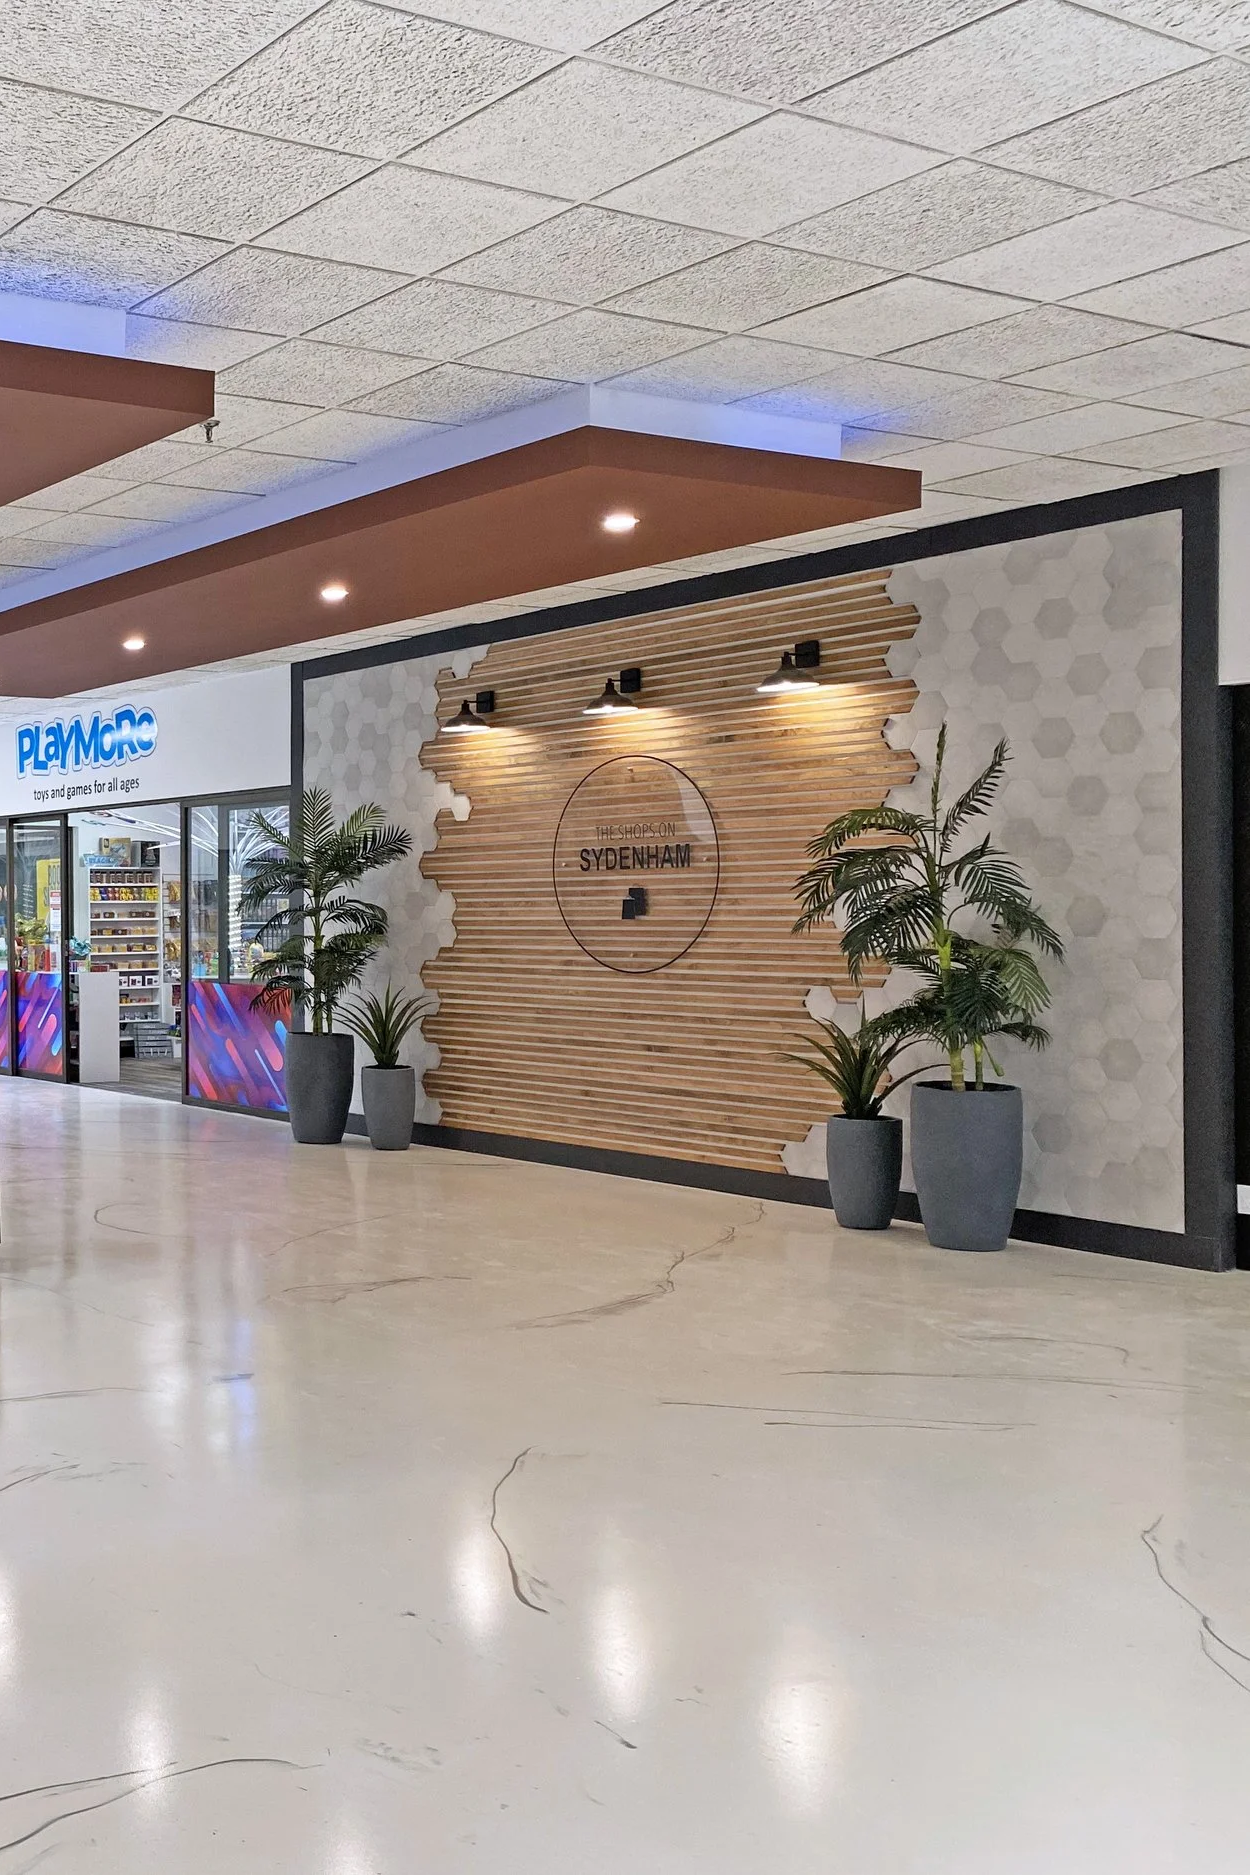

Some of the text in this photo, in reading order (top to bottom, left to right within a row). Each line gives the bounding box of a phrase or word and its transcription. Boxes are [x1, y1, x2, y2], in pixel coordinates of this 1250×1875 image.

[33, 777, 140, 802] toys and games for all ages
[595, 822, 676, 841] THE SHOPS ON
[579, 843, 690, 872] SYDENHAM
